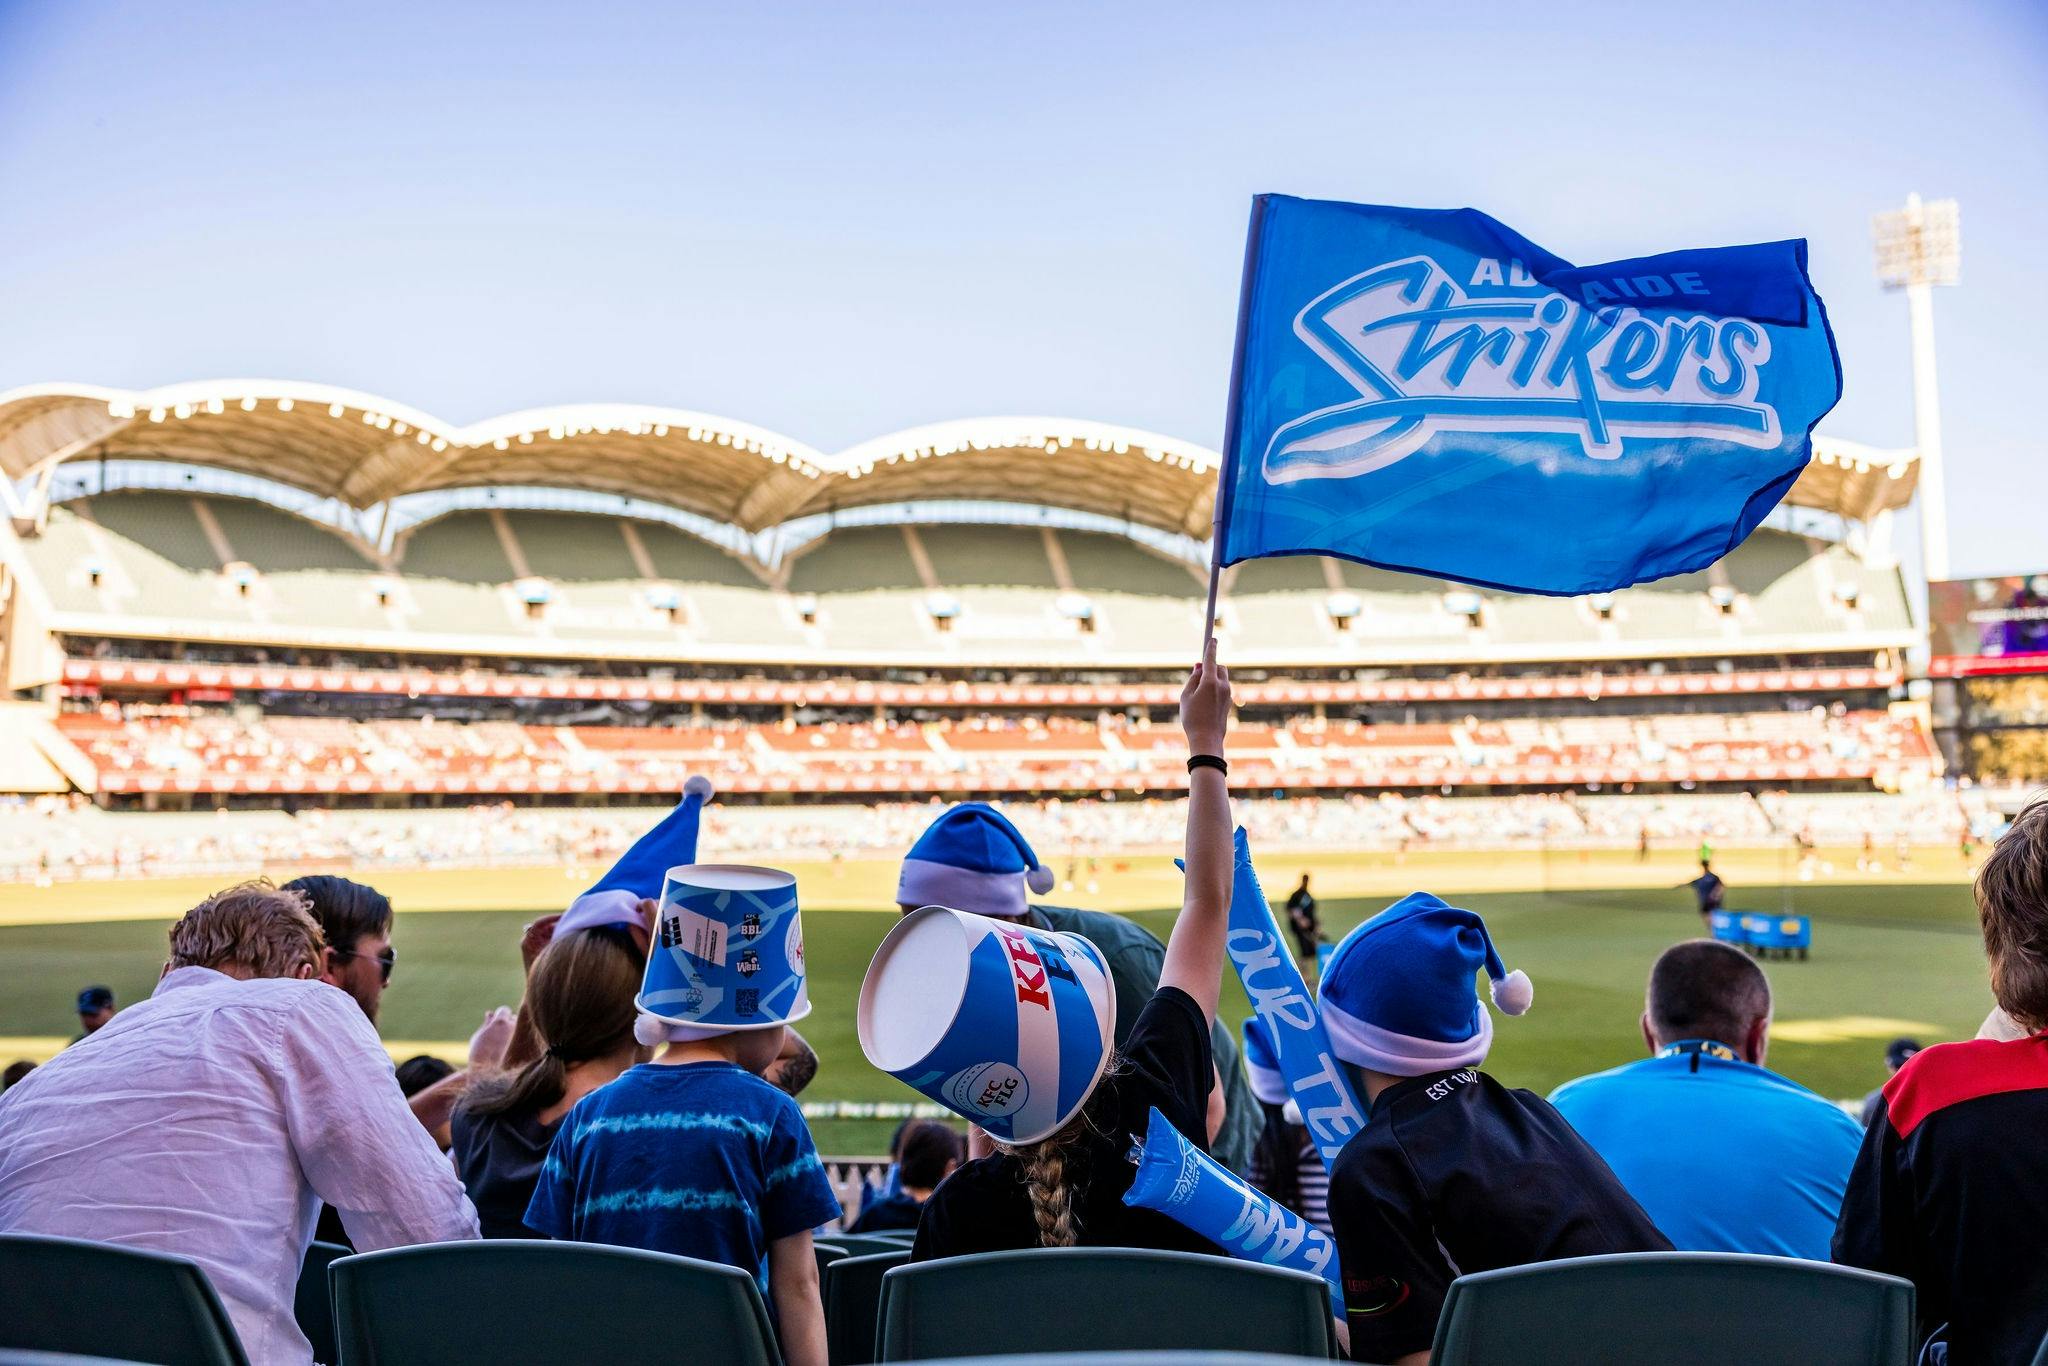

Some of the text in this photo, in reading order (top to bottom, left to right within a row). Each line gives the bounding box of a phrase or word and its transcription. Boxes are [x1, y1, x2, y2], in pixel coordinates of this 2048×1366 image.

[1469, 257, 1711, 304] ADAIDE
[1263, 256, 1781, 484] Strikers
[741, 925, 762, 935] BBL
[1029, 934, 1077, 987] FL
[1226, 928, 1316, 1059] OUR
[976, 1080, 1002, 1108] KFC
[993, 1077, 1018, 1107] FLG
[1425, 1079, 1455, 1100] EST
[1221, 1182, 1334, 1277] EAM
